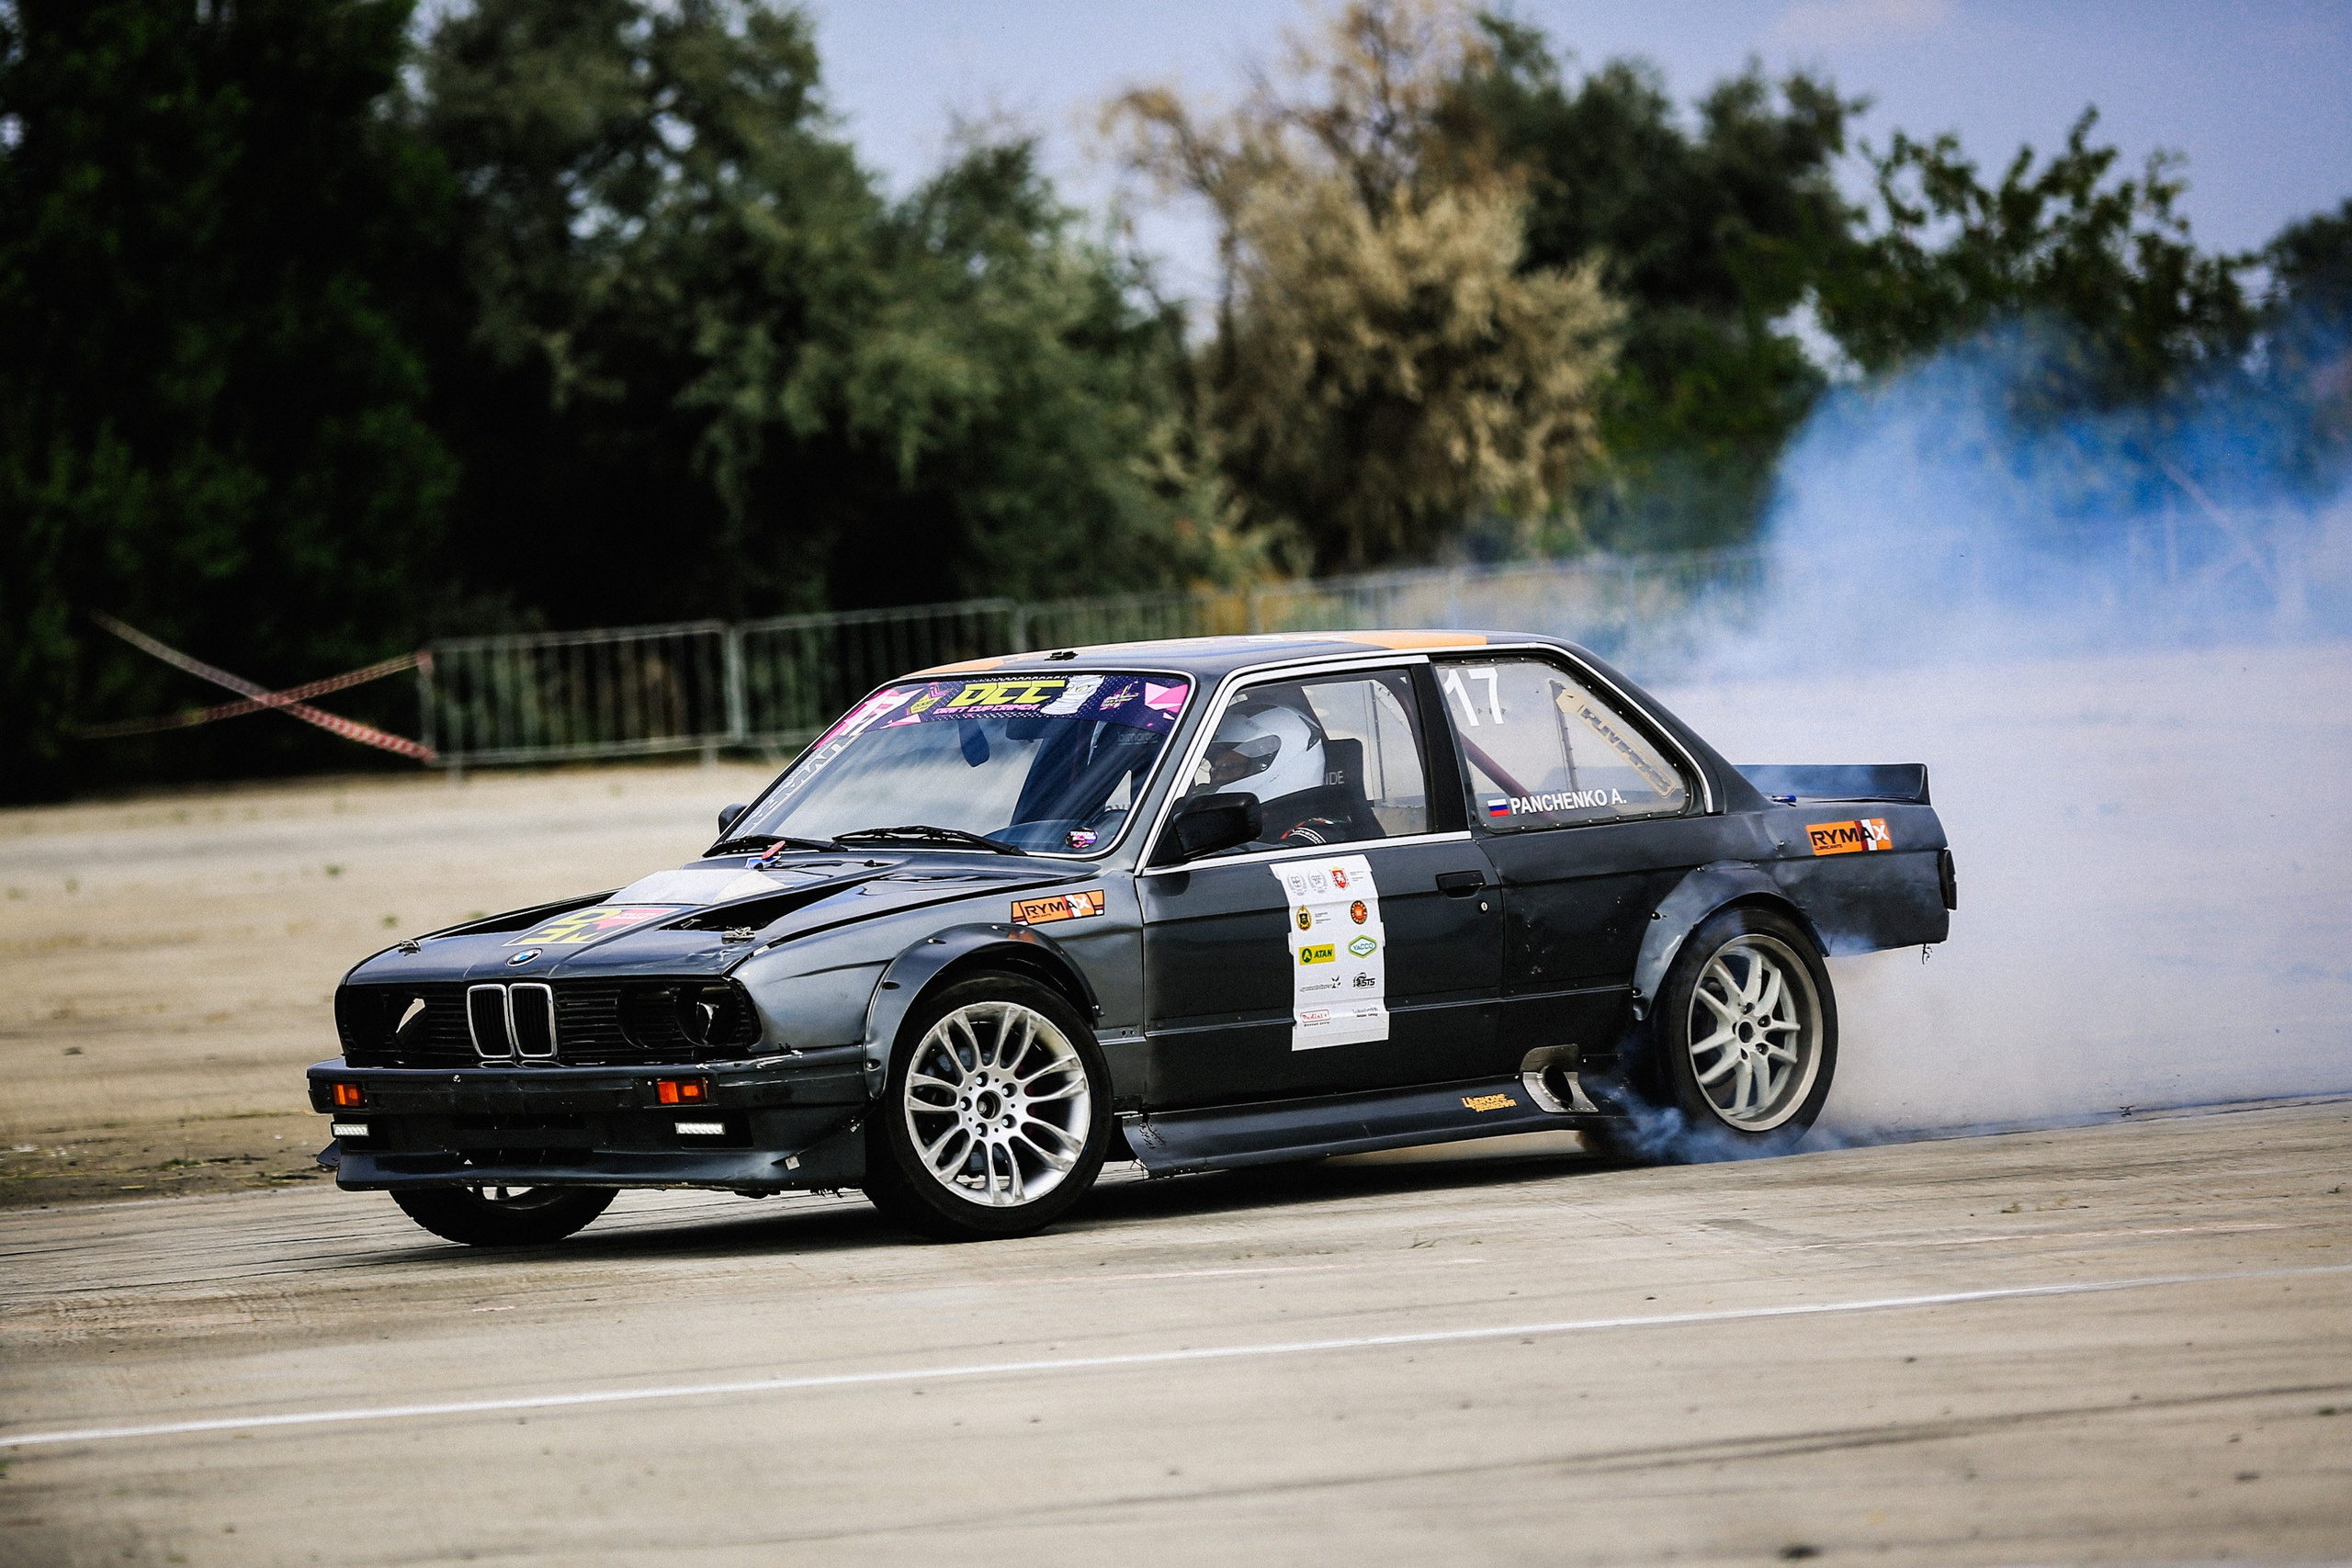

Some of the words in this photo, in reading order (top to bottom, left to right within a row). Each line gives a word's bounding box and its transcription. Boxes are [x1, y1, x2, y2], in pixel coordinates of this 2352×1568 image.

[1443, 668, 1505, 727] 17
[933, 706, 968, 715] DRIFT
[1510, 788, 1608, 815] PANCHENKO
[1611, 787, 1628, 806] A.
[1809, 824, 1890, 846] RYMAX
[1023, 896, 1091, 917] RYMAX
[1314, 949, 1333, 959] ATAN
